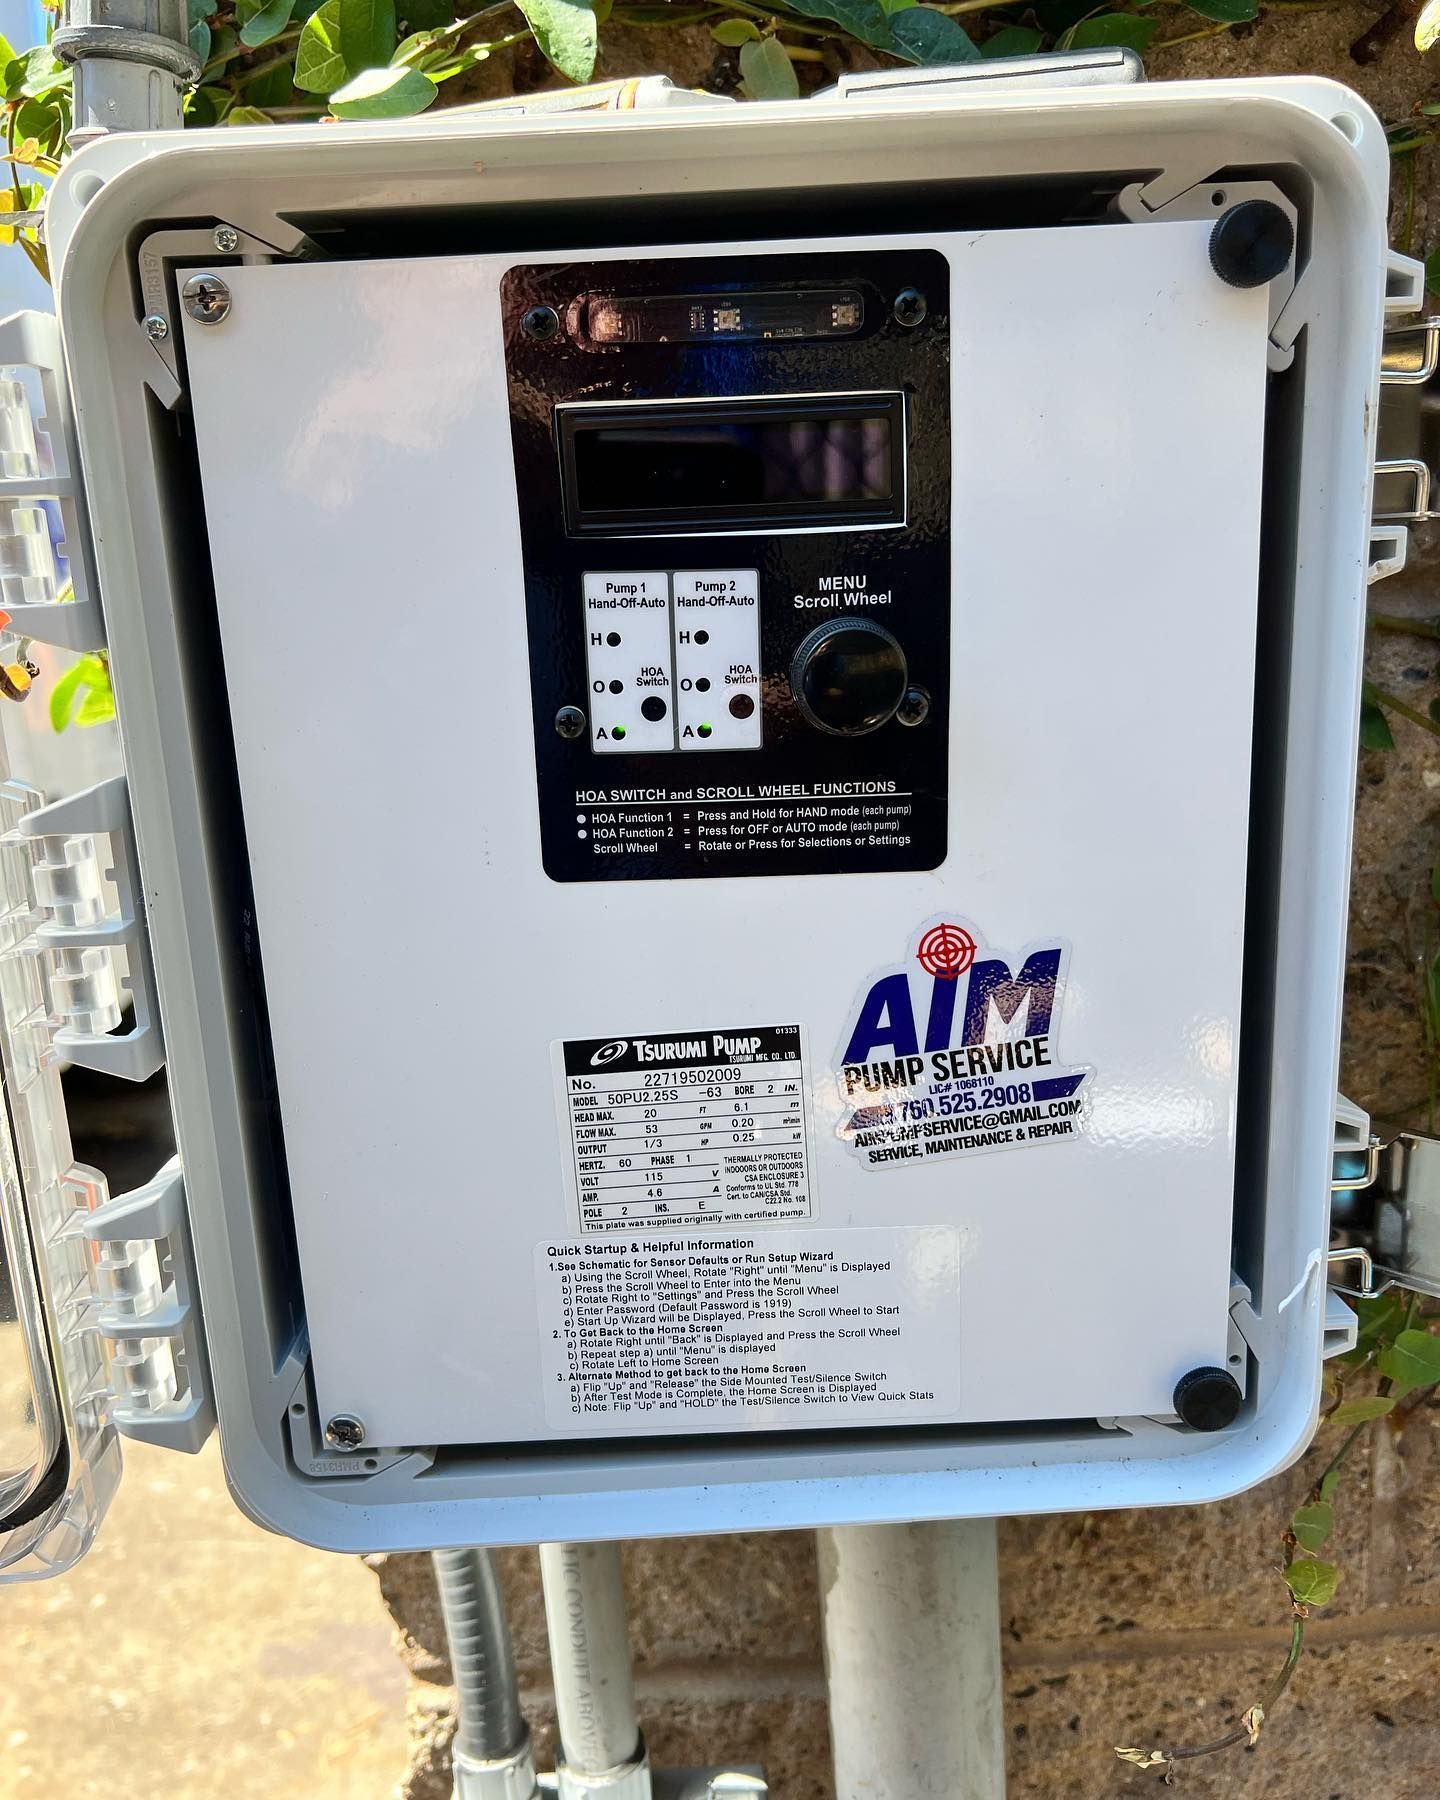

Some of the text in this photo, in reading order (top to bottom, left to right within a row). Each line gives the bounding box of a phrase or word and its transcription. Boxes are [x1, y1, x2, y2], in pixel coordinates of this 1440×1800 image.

[606, 583, 646, 595] Pump 1
[696, 582, 735, 593] Pump 2
[819, 576, 866, 591] MENU
[589, 597, 665, 609] Hand-Off-Auto
[677, 596, 754, 607] Hand-Off-Auto
[794, 591, 892, 609] Scroll Wheel
[591, 633, 602, 645] H
[679, 632, 690, 644] H
[641, 667, 664, 676] HOA
[729, 665, 752, 674] HOA
[593, 681, 605, 693] O
[636, 676, 669, 686] Switch
[680, 679, 692, 691] O
[724, 674, 757, 684] Switch
[596, 728, 607, 740] A
[683, 726, 694, 738] A
[575, 781, 895, 801] HOA SWITCH and SCROLL WHEEL FUNCTIONS
[591, 813, 616, 823] HOA
[618, 812, 663, 822] Function
[666, 811, 671, 821] 1
[697, 810, 726, 820] Press
[729, 809, 748, 819] and
[752, 808, 775, 818] Hold
[778, 807, 793, 818] for
[796, 806, 827, 817] HAND
[830, 805, 859, 816] mode
[862, 805, 883, 816] (each
[886, 804, 911, 816] pump)
[592, 828, 616, 838] HOA
[619, 827, 664, 837] Function
[667, 826, 673, 836] 2
[698, 825, 727, 835] Press
[729, 824, 744, 834] for
[747, 823, 768, 834] OFF
[772, 825, 783, 833] or
[785, 822, 815, 832] AUTO
[818, 821, 847, 831] mode
[850, 820, 871, 832] (each
[874, 820, 899, 831] pump)
[593, 842, 623, 853] Scroll
[625, 842, 657, 852] Wheel
[698, 840, 731, 850] Rotate
[734, 841, 745, 849] or
[748, 839, 777, 848] Press
[780, 838, 795, 848] for
[797, 836, 851, 847] Selections
[854, 837, 865, 845] or
[868, 834, 910, 846] Settings
[842, 948, 1062, 1066] AIM
[633, 1034, 761, 1062] TSURUMI PUMP
[844, 1036, 1051, 1096] PUMP SERVICE
[571, 1067, 741, 1090] No. 22719502009
[929, 1076, 994, 1095] LIC# 1068110
[572, 1083, 797, 1106] MODEL 50PU2.25S -63 BORE 2 IN.
[574, 1112, 594, 1122] HEAD
[596, 1111, 614, 1121] MAX.
[644, 1108, 657, 1118] 20
[699, 1106, 706, 1114] FT
[734, 1102, 748, 1111] 6.1
[575, 1128, 596, 1138] FLOW
[597, 1127, 616, 1137] MAX.
[645, 1124, 657, 1133] 53
[731, 1117, 753, 1127] 0.20
[577, 1132, 754, 1154] OUTPUT 1/3 0.25
[868, 1121, 1073, 1163] SERVICE, MAINTENANCE & REPAIR
[578, 1154, 690, 1171] HERTZ. 60 PHASE 1
[723, 1151, 802, 1163] THERMALLY PROTECTED
[758, 1163, 767, 1171] OR
[768, 1161, 803, 1170] OUTDOORS
[580, 1176, 598, 1186] VOLT
[645, 1171, 662, 1181] 115
[744, 1174, 758, 1182] CSA
[758, 1171, 798, 1181] ENCLOSURE
[582, 1192, 598, 1202] AMP.
[647, 1187, 662, 1197] 4.6
[583, 1200, 705, 1218] POLE 2 INS. E
[585, 1222, 603, 1230] This
[605, 1221, 625, 1230] plate
[646, 1216, 681, 1227] supplied
[684, 1214, 722, 1224] originally
[724, 1212, 741, 1220] with
[743, 1210, 777, 1219] certified
[779, 1209, 805, 1217] pump.
[547, 1238, 753, 1256] Quick Startup & Helpful Information
[578, 1259, 630, 1270] Schematic
[633, 1258, 647, 1267] for
[650, 1257, 686, 1267] Sensor
[688, 1255, 728, 1265] Defaults
[745, 1254, 765, 1263] Run
[768, 1253, 796, 1263] Setup
[799, 1251, 833, 1261] Wizard
[552, 1323, 722, 1338] 2. To Get Back to the Home Screen
[564, 1588, 590, 1682] CONDUIT
